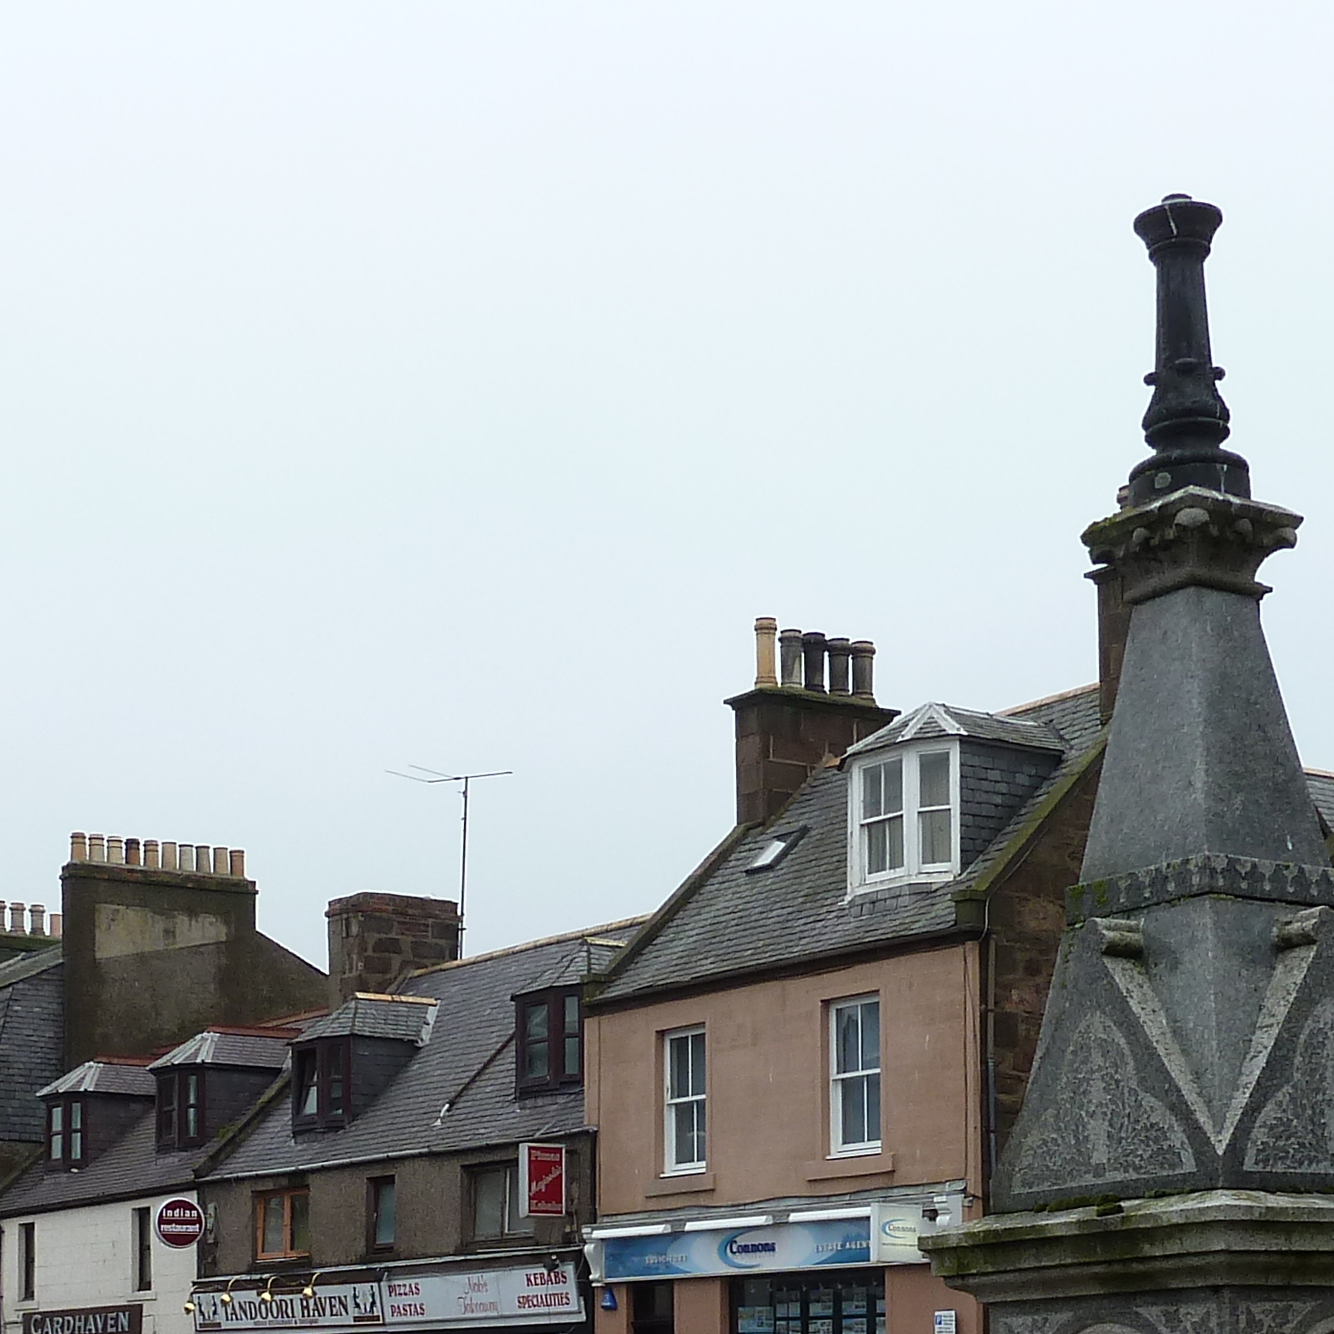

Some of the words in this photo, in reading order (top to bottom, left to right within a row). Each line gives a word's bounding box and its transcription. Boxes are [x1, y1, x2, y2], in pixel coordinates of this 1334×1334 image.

[525, 1270, 568, 1287] KEBABS
[388, 1283, 421, 1298] PIZZAS
[224, 1298, 297, 1322] TANDOORI
[299, 1295, 349, 1319] HAVEN
[517, 1291, 571, 1310] SPECIALITIES
[390, 1303, 426, 1318] PASTAS
